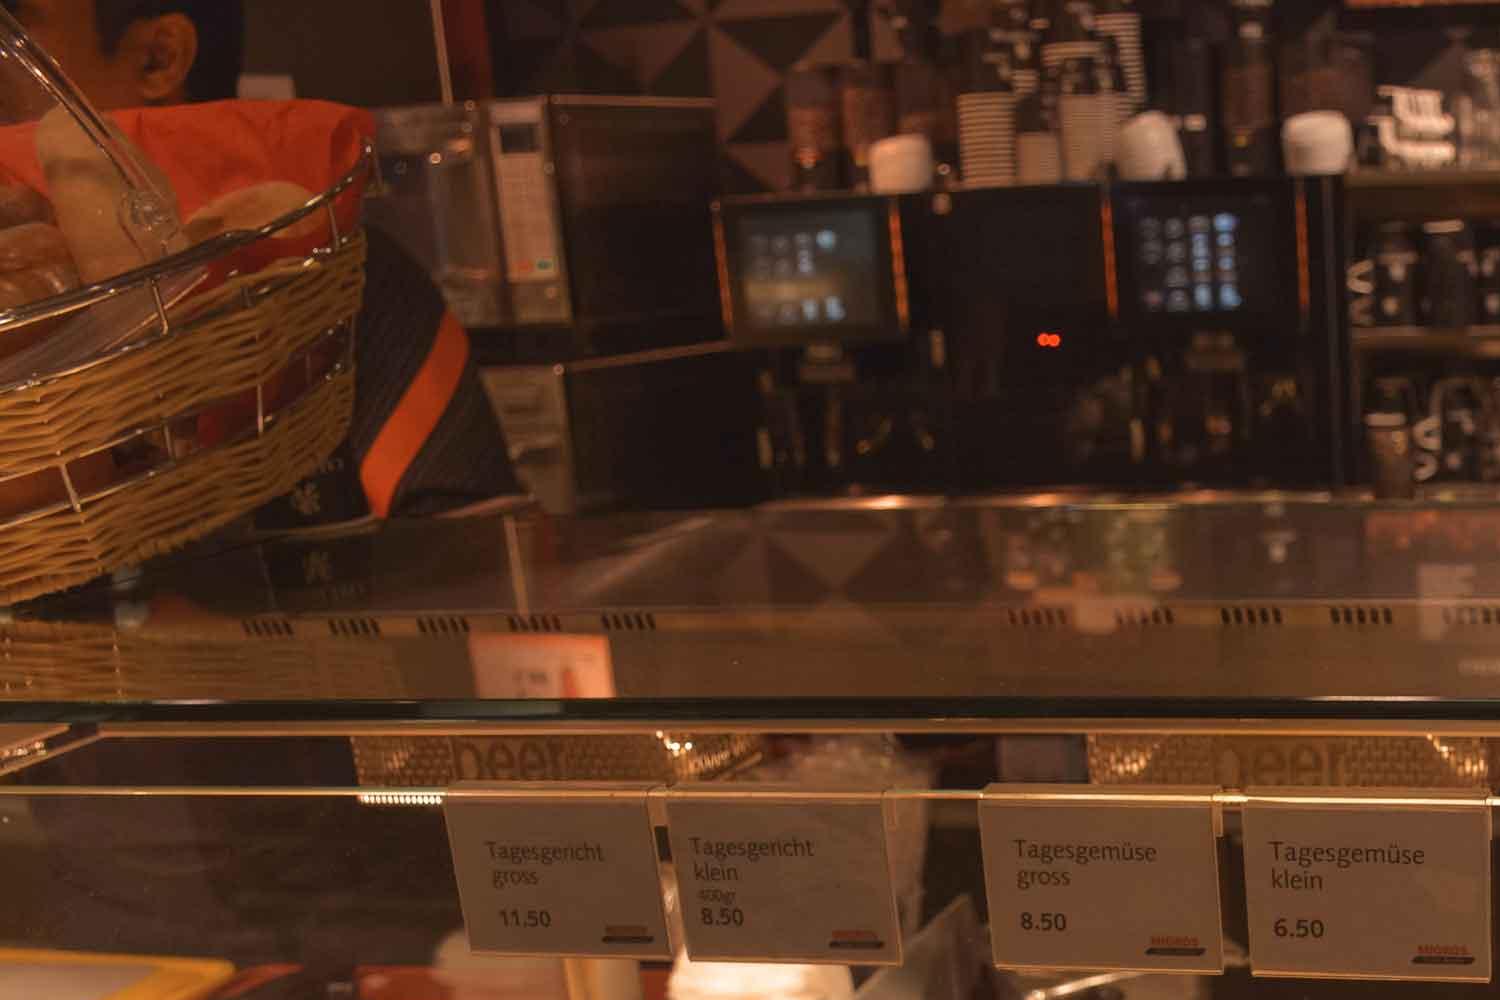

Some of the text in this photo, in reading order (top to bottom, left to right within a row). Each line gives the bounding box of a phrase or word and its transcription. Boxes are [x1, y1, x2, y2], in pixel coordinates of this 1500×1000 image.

[487, 840, 605, 866] Tagesgericht
[689, 837, 815, 863] Tagesgericht
[1014, 839, 1158, 866] Tagesgemüse
[1268, 840, 1426, 868] Tagesgemüse
[492, 867, 539, 889] gross
[694, 863, 739, 882] klein
[1016, 868, 1072, 889] gross
[1271, 868, 1324, 891] klein
[499, 910, 553, 928] 11.50
[700, 907, 745, 926] 8.50
[1020, 912, 1067, 932] 8.50
[1273, 918, 1325, 938] 6.50
